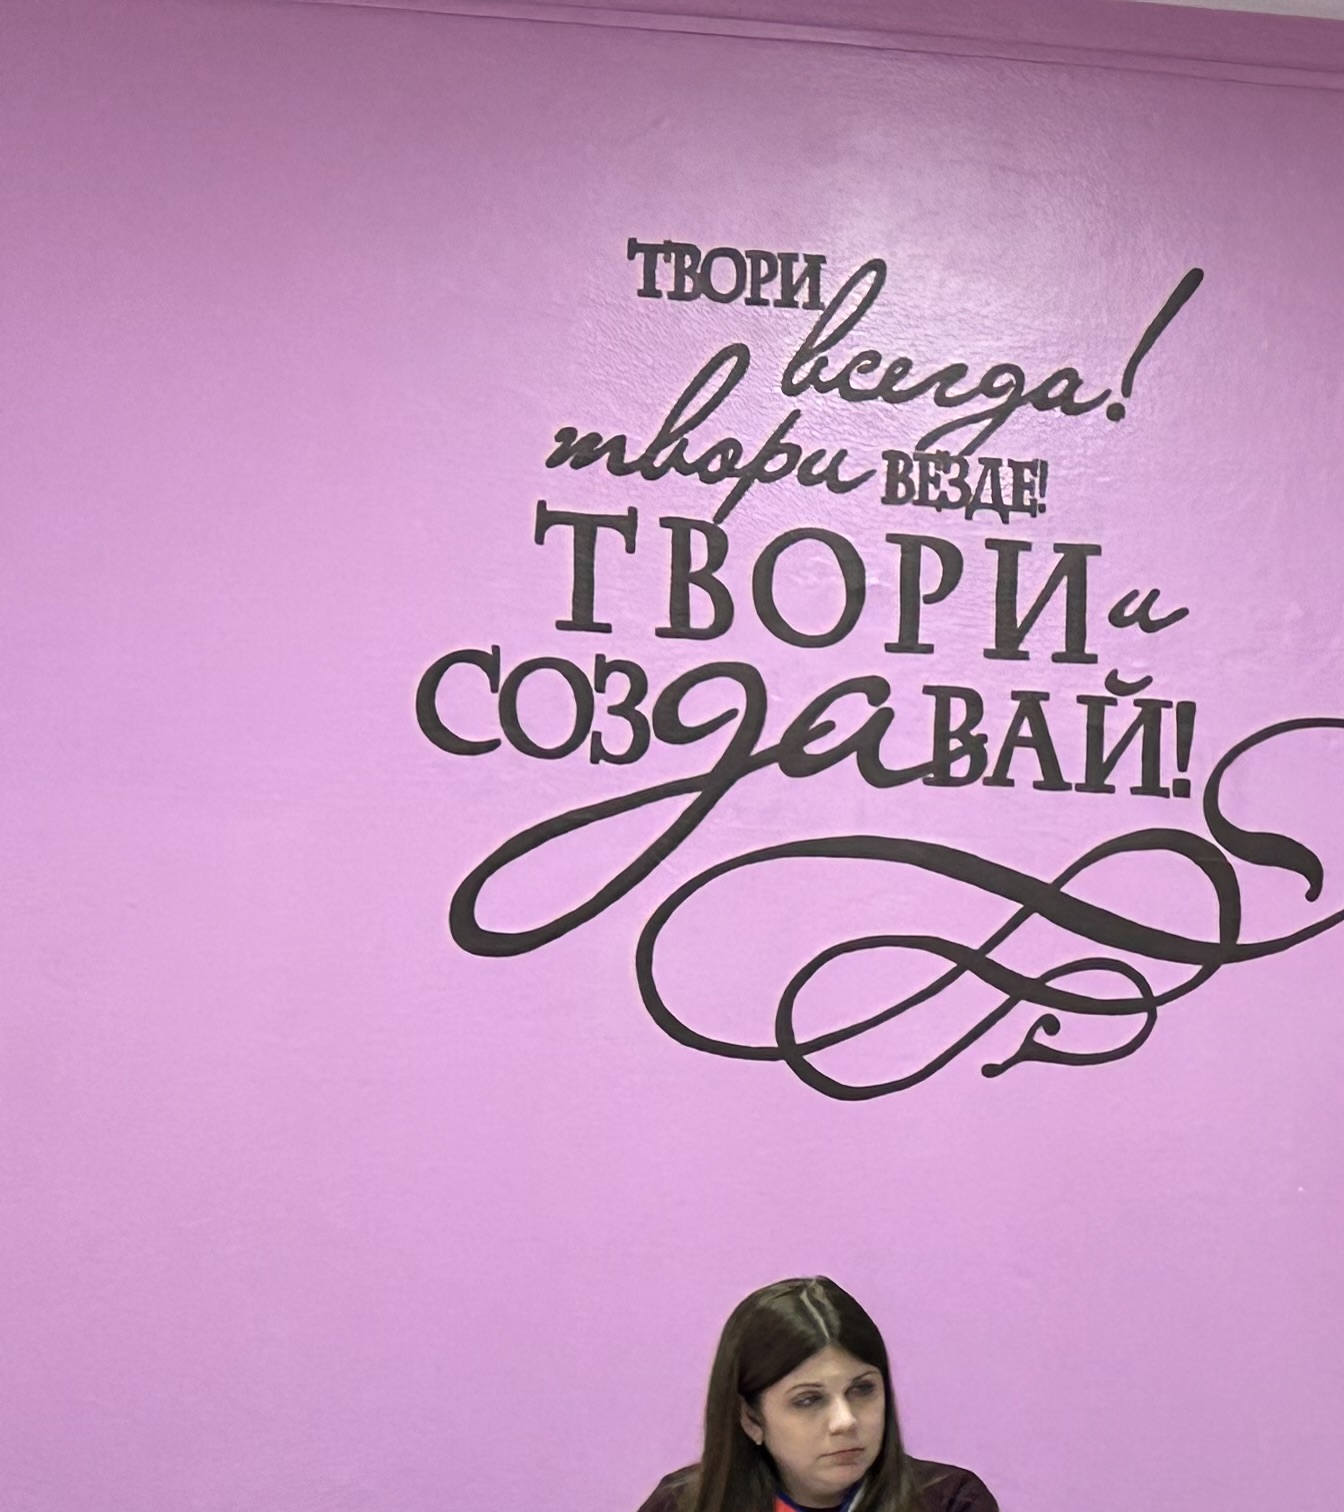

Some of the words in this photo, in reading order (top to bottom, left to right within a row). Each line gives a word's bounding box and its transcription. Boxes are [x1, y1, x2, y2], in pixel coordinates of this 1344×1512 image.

[627, 237, 828, 310] ТВОРИ
[881, 449, 1048, 523] ВЕЗДЕ!
[534, 499, 1103, 665] ТВОРИ
